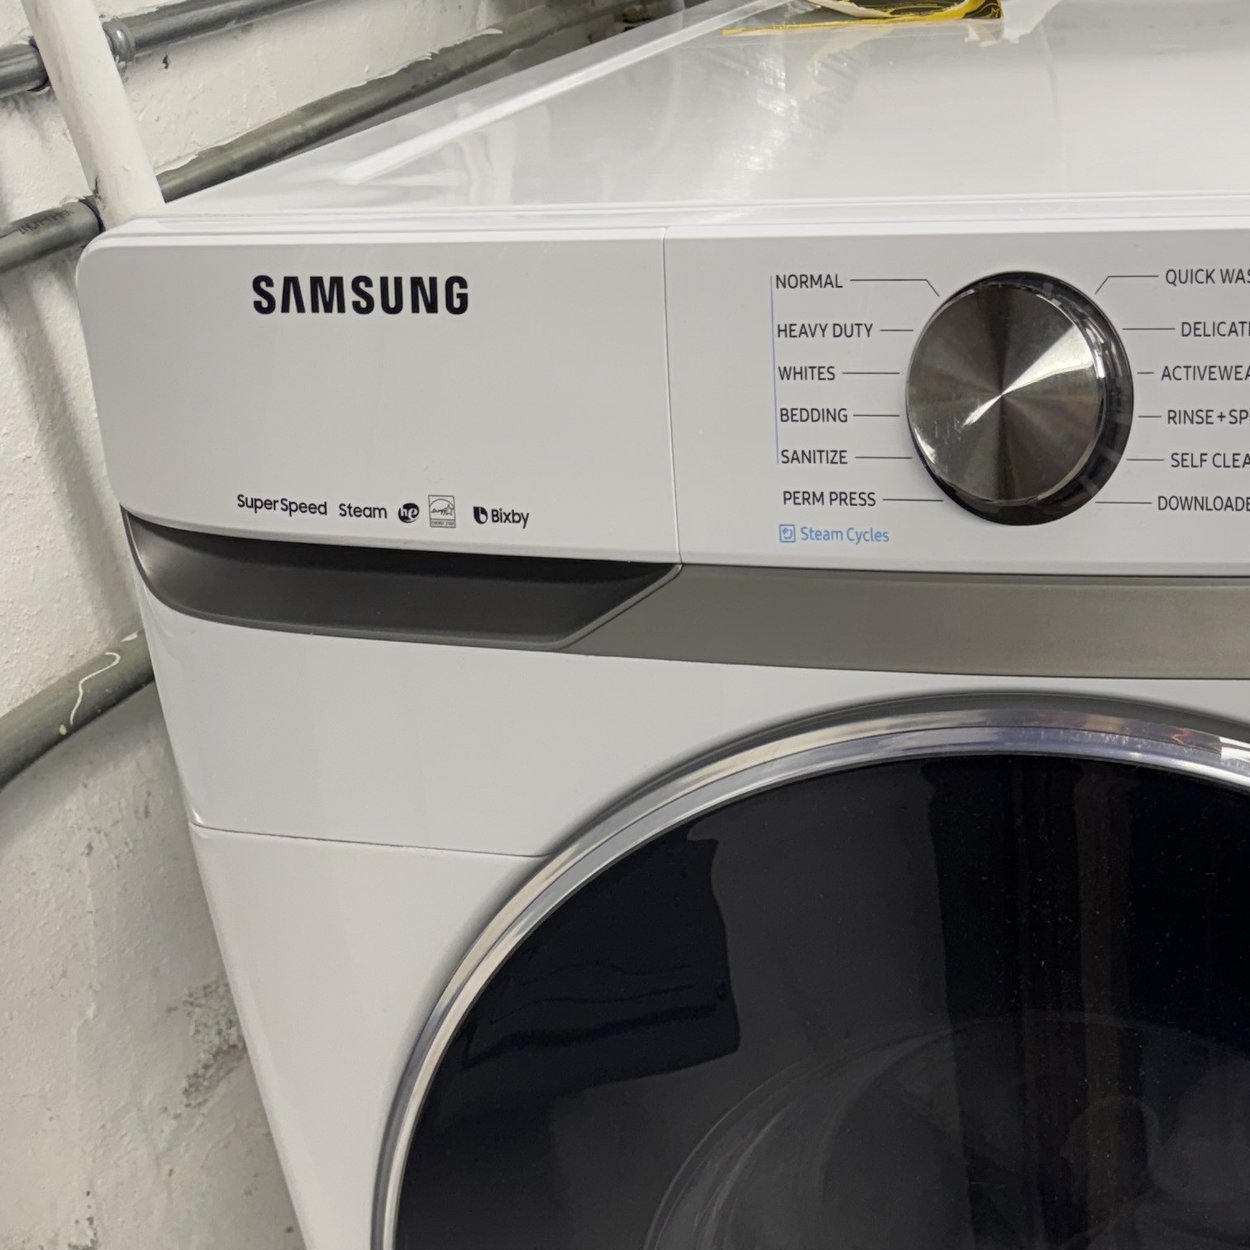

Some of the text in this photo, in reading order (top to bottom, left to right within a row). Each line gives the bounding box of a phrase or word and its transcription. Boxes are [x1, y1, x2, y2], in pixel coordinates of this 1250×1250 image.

[775, 273, 844, 290] NORMAL
[1165, 268, 1216, 286] QUICK
[251, 274, 469, 316] SAMSUNG
[777, 322, 874, 339] HEAVY DUTY
[777, 365, 836, 381] WHITES
[779, 407, 848, 423] BEDDING
[780, 448, 848, 465] SANITIZE
[1170, 452, 1209, 469] SELF
[783, 490, 877, 507] PERM PRESS
[338, 502, 388, 519] Steam
[490, 507, 530, 530] Bixby
[800, 526, 890, 545] Steam Cycles
